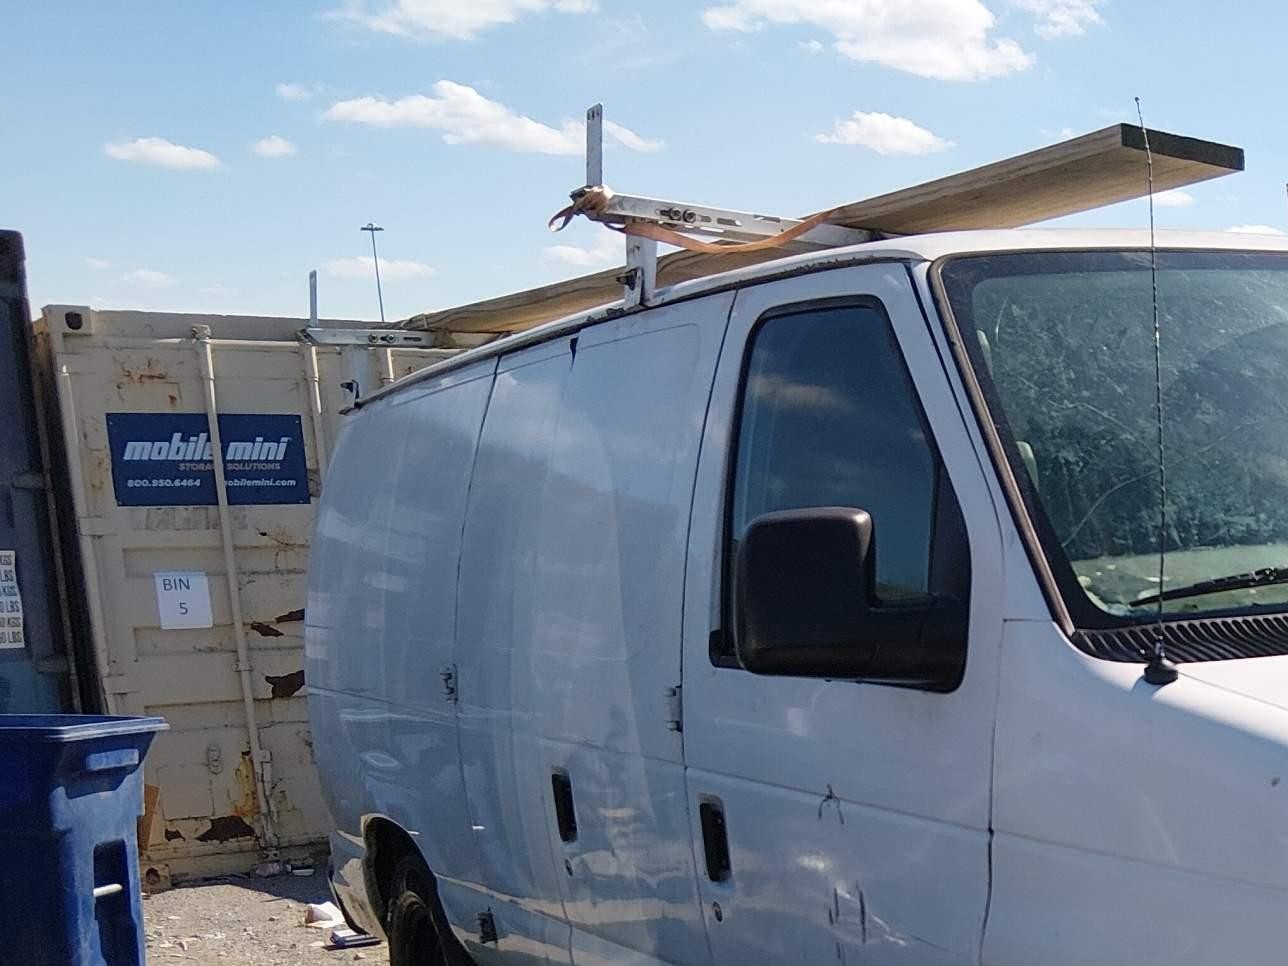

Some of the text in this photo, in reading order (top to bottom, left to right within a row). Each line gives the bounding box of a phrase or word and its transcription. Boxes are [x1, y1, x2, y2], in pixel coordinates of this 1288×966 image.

[226, 437, 288, 461] mini
[178, 462, 281, 471] STORA SOLUTIONS
[127, 478, 201, 488] 800.950.6464
[162, 578, 191, 591] BIN
[6, 600, 20, 613] LBS
[178, 602, 189, 615] 5
